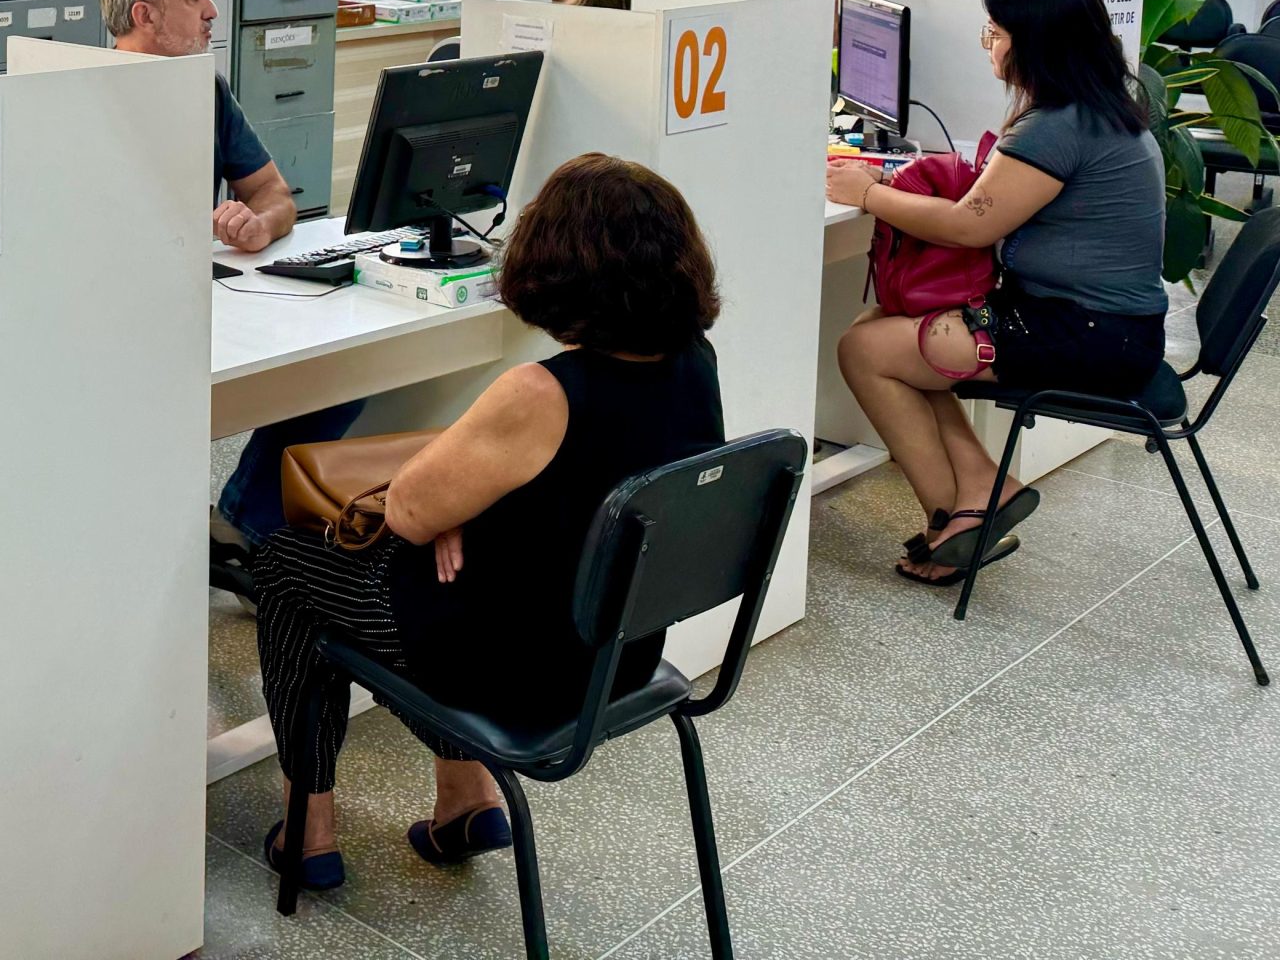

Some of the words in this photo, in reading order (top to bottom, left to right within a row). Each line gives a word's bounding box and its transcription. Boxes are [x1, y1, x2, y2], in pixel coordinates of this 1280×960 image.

[1110, 12, 1125, 25] RTIR
[1126, 11, 1135, 24] DE
[673, 26, 728, 120] 02
